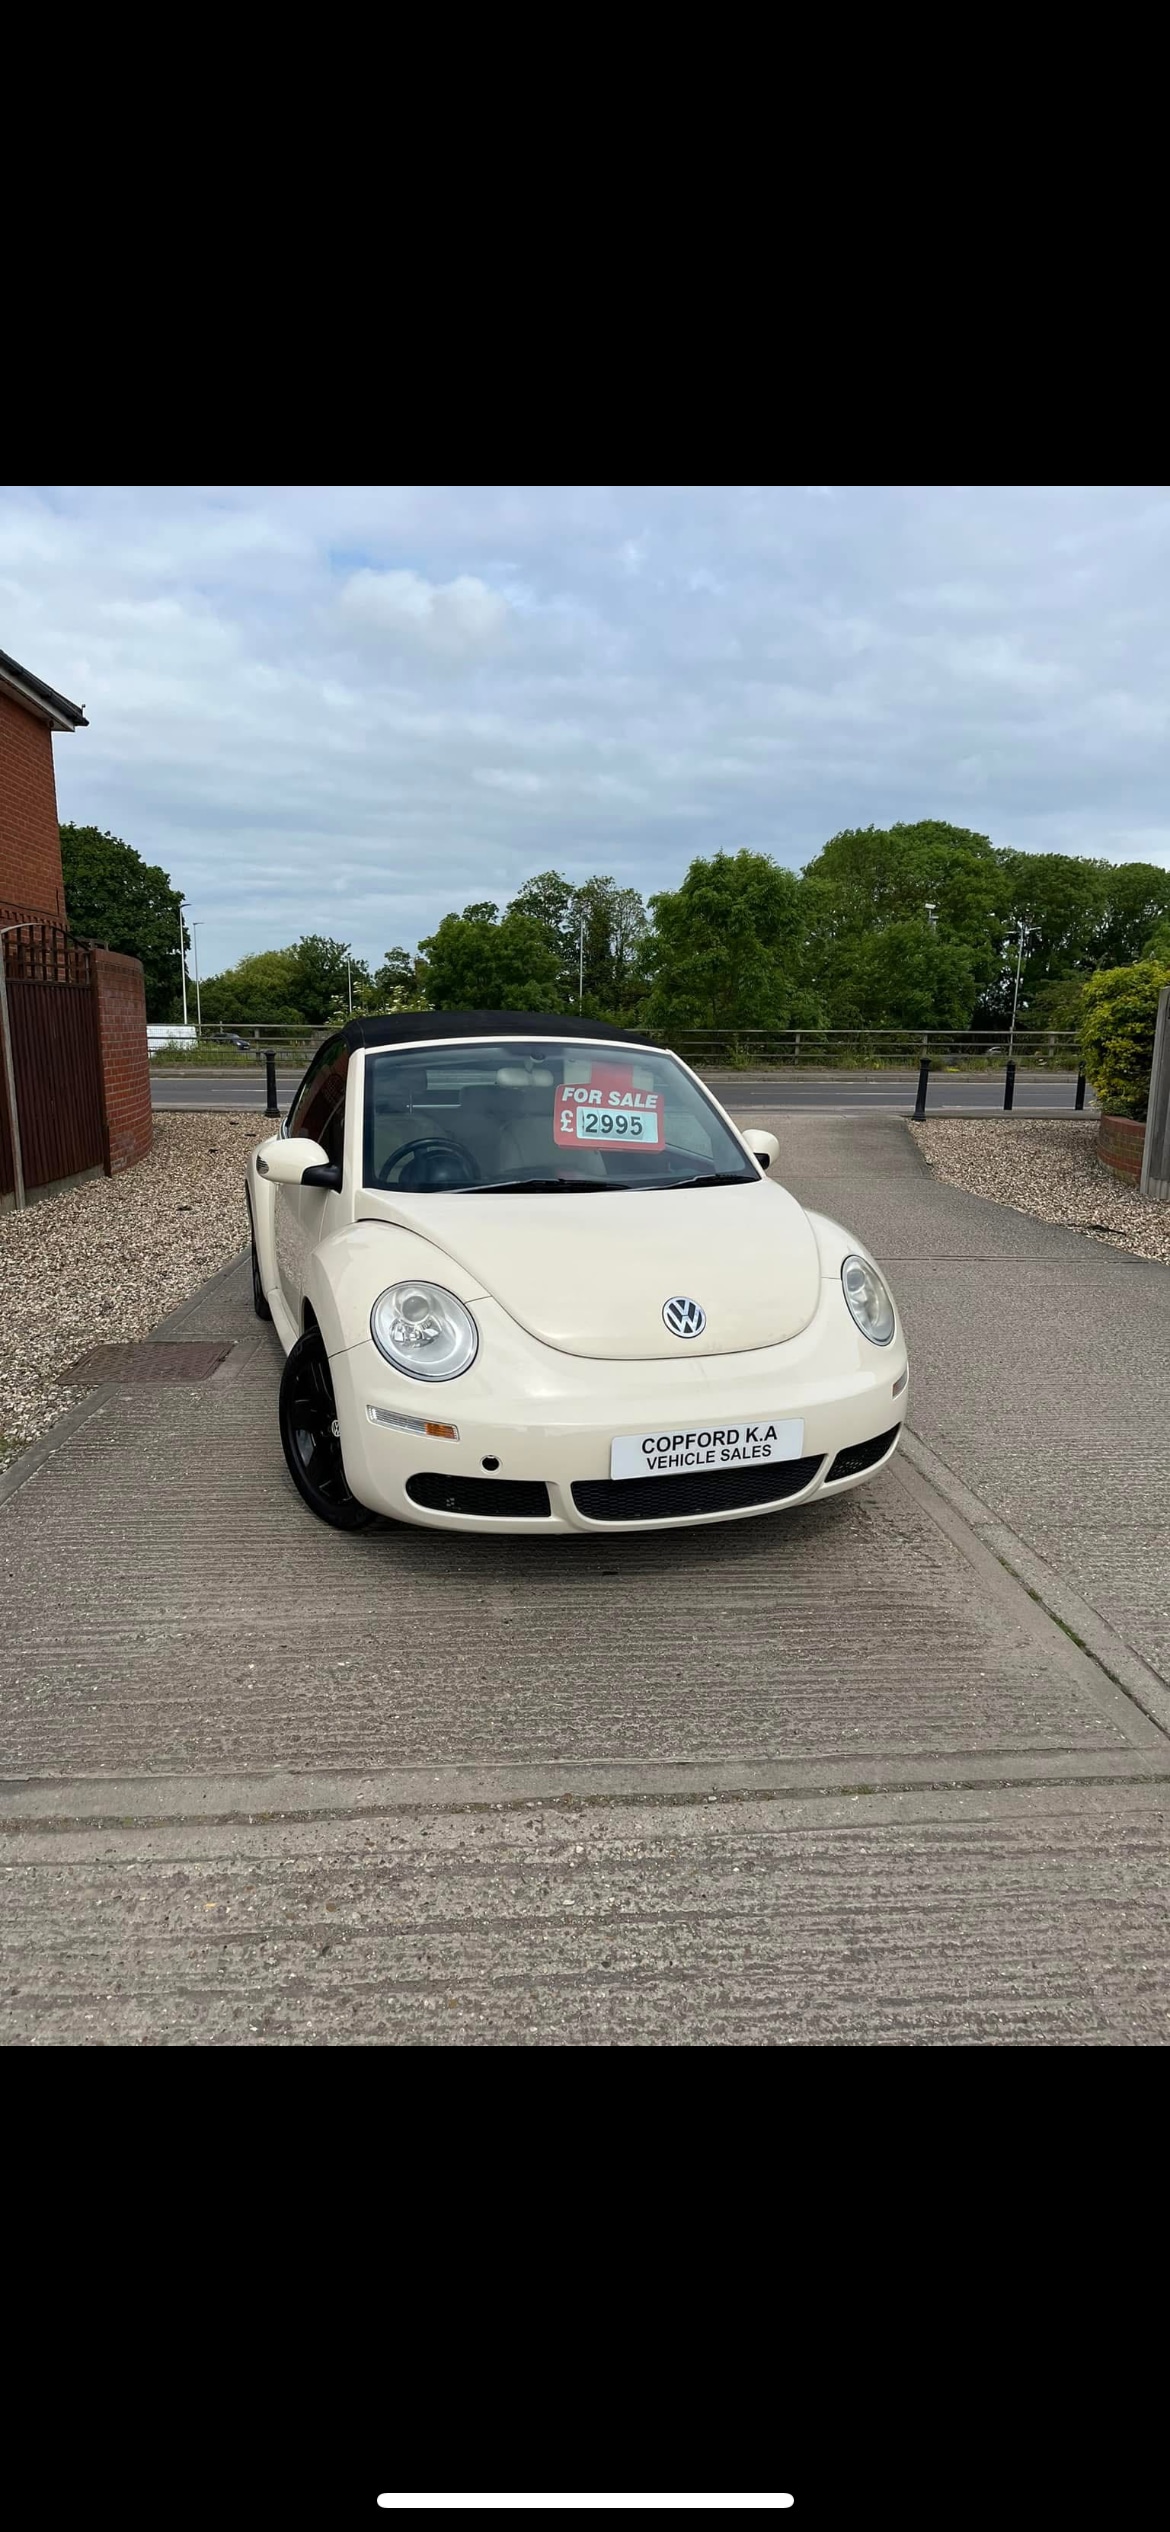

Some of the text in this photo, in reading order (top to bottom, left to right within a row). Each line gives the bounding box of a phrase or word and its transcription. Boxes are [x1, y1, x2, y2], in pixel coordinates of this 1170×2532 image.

[562, 1087, 658, 1109] FOR SALE
[585, 1113, 643, 1136] 2995
[641, 1425, 778, 1454] COPFORD K.A
[646, 1444, 772, 1470] VEHICLE SALES
